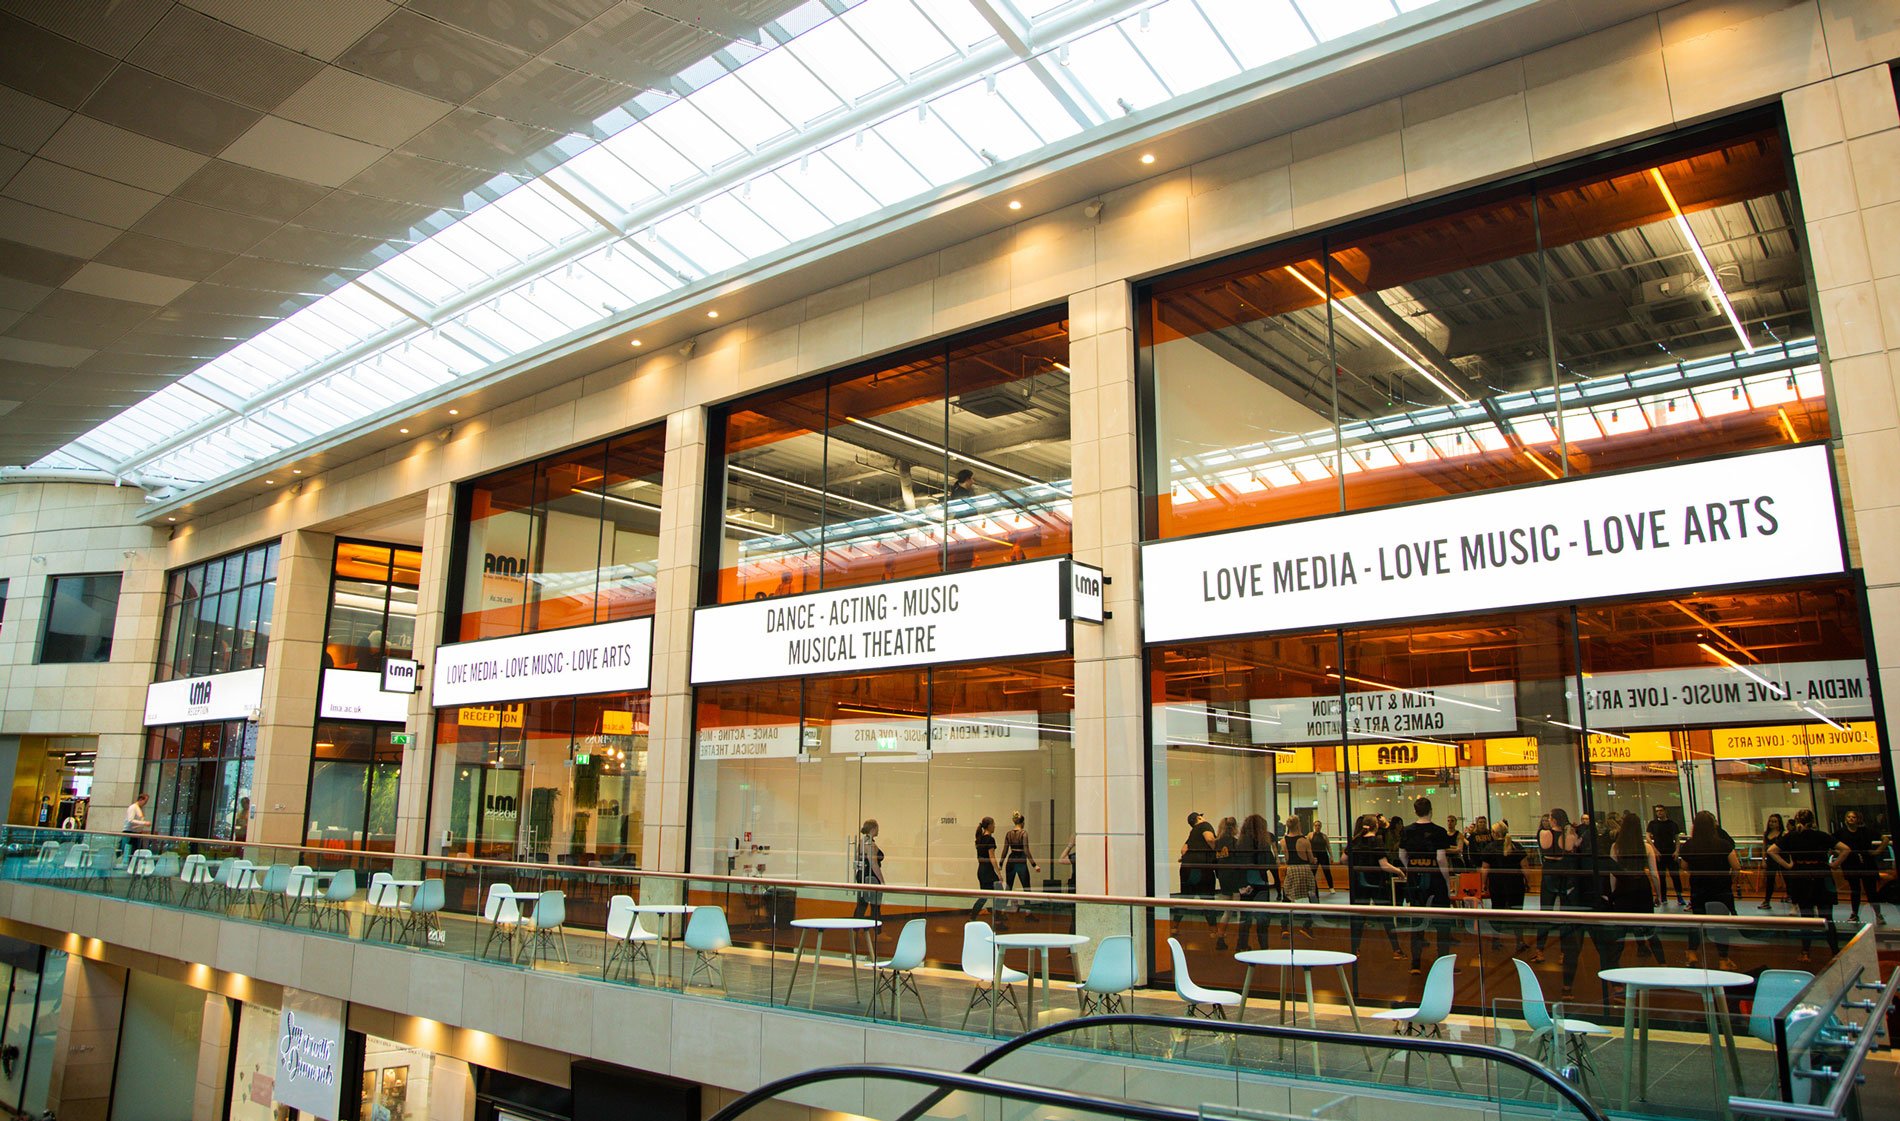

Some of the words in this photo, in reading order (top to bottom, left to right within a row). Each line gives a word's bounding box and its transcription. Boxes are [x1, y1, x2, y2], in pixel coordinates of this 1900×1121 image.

[1203, 563, 1263, 602] LOVE
[1273, 553, 1357, 593] MEDIA
[1379, 538, 1450, 581] LOVE
[1461, 524, 1560, 571] MUSIC
[1584, 509, 1670, 557] LOVE
[1683, 495, 1780, 545] ARTS
[1075, 573, 1099, 597] LMA
[767, 603, 815, 633] DANCE
[829, 594, 887, 626] ACTING
[903, 584, 959, 617] MUSIC
[789, 634, 857, 665] MUSICAL
[863, 625, 936, 658] THEATRE
[389, 665, 413, 677] LMA
[447, 664, 468, 684] LOVE
[470, 660, 497, 682] MEDIA
[505, 656, 529, 678] LOVE
[532, 652, 564, 675] MUSIC
[572, 648, 598, 671] LOVE
[602, 644, 631, 668] ARTS
[190, 681, 212, 705] LMA
[463, 711, 517, 723] RECEPTON
